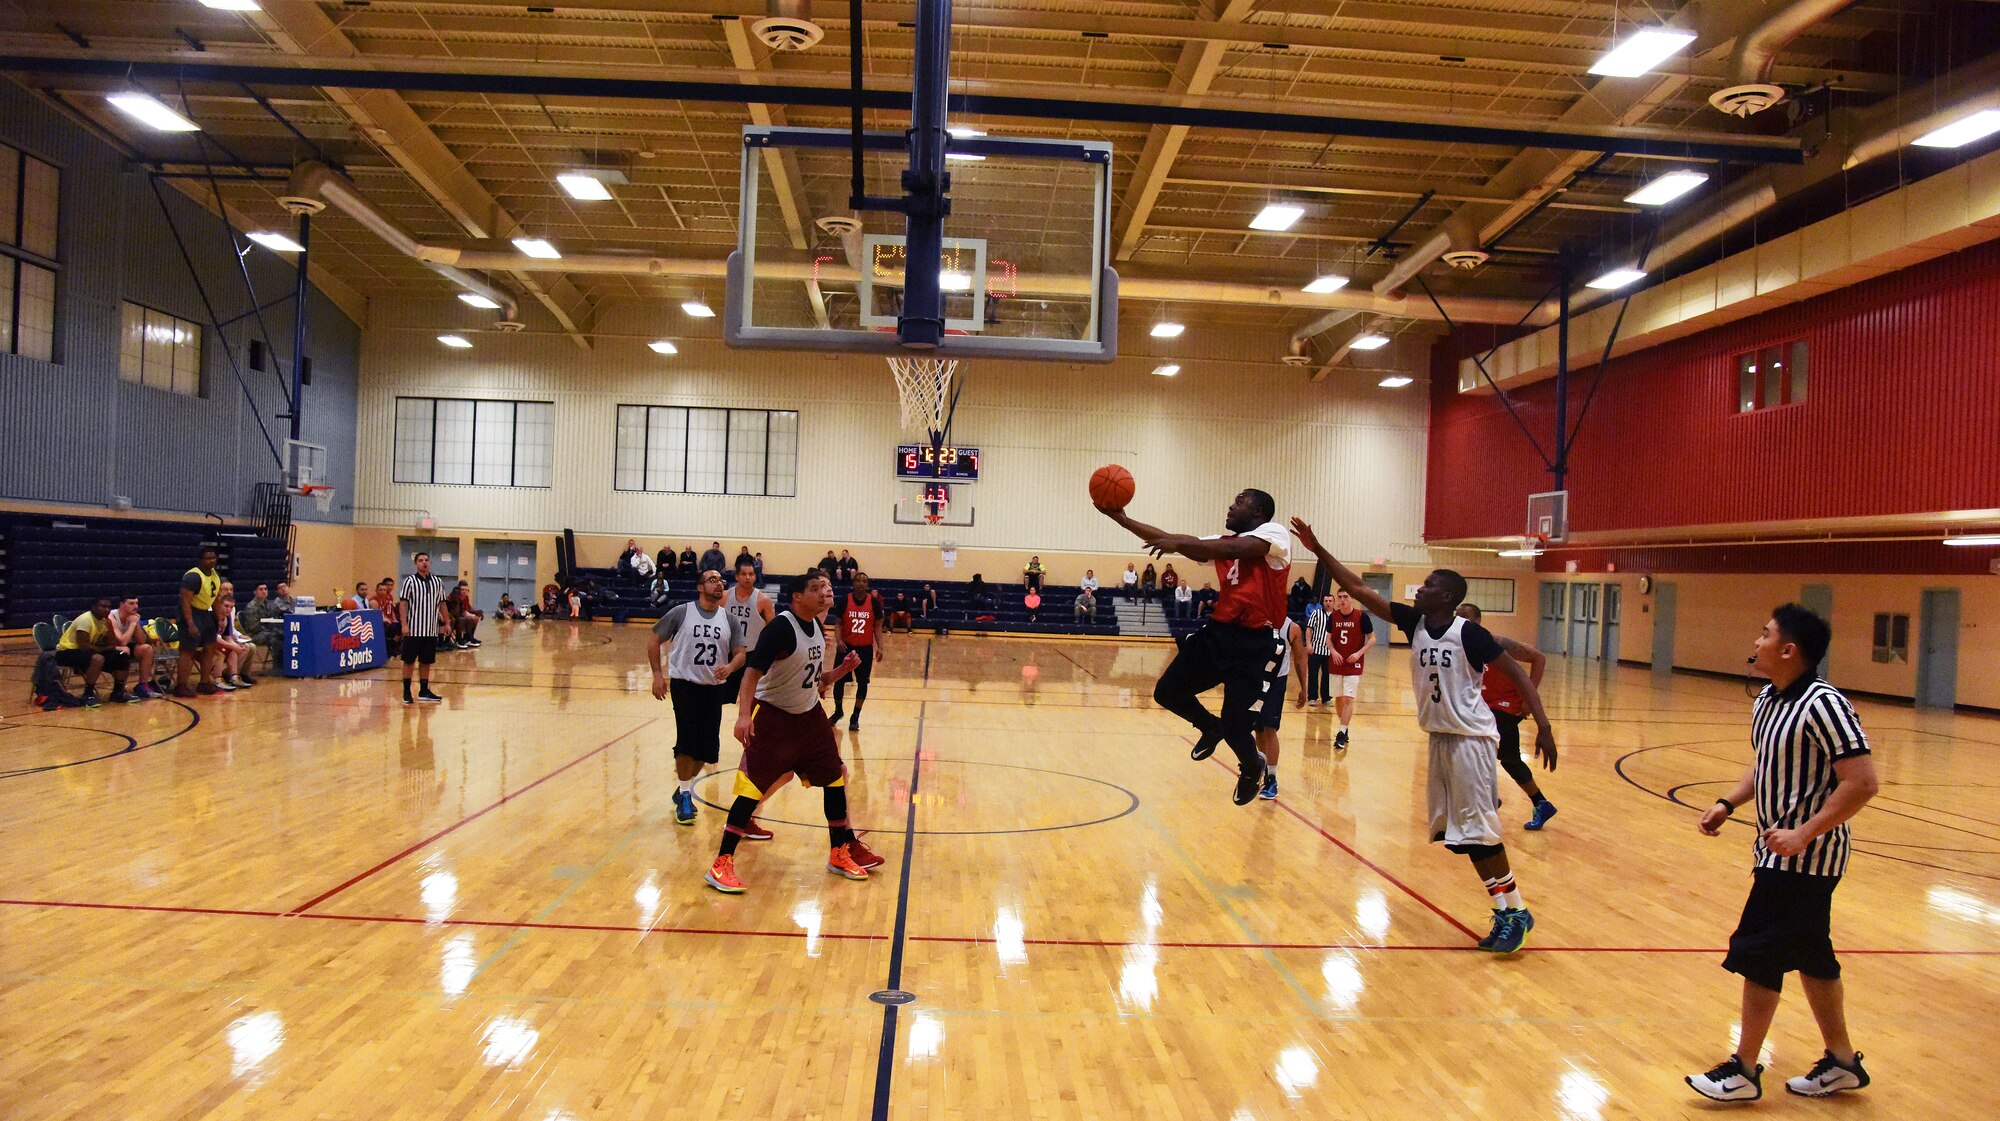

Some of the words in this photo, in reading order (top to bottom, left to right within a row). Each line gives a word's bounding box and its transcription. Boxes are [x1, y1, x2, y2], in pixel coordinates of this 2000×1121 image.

[906, 454, 917, 469] 15
[970, 455, 978, 470] 7
[1226, 558, 1240, 586] 4
[730, 605, 751, 618] CES
[693, 624, 721, 640] CES
[851, 618, 866, 634] 22
[290, 621, 300, 670] MAFB
[1340, 629, 1348, 645] 5
[340, 652, 346, 668] &
[347, 646, 373, 669] Sports
[693, 642, 718, 667] 23
[808, 645, 821, 661] CES
[1420, 647, 1452, 668] CES
[801, 662, 823, 689] 24
[1428, 672, 1442, 703] 3
